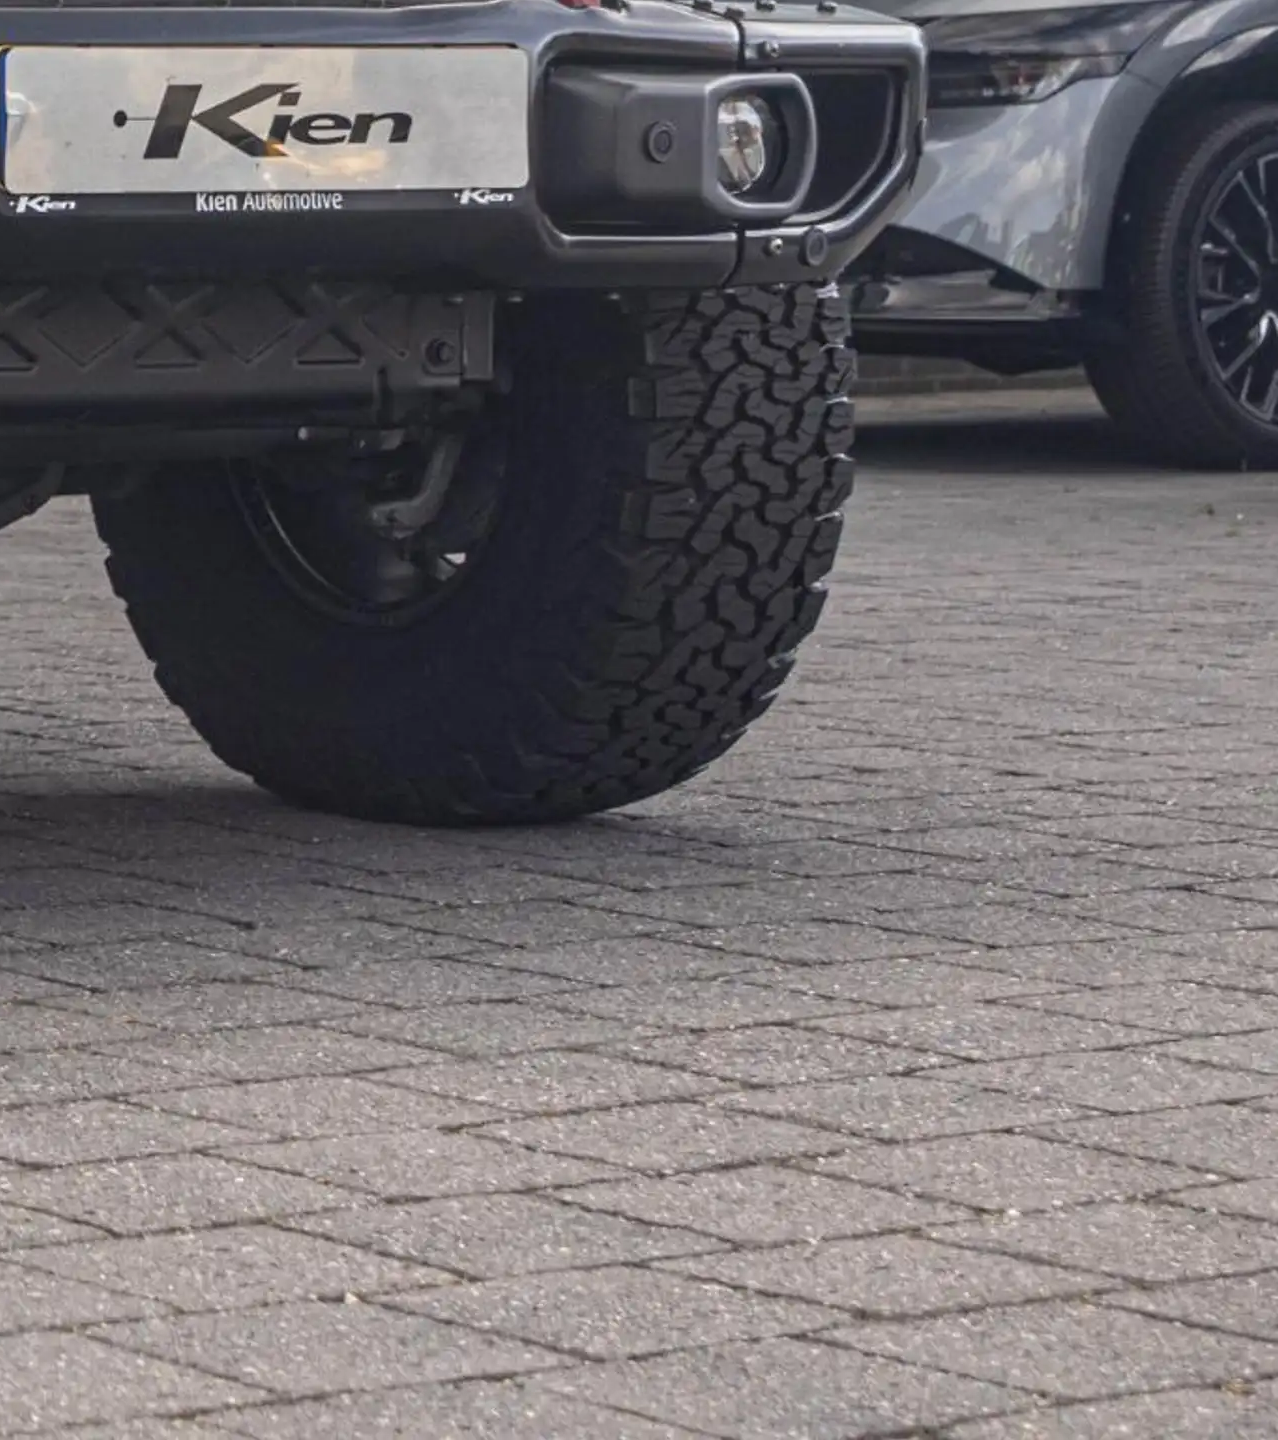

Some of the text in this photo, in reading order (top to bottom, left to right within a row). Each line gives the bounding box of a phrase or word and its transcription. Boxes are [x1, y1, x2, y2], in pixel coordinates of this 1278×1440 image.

[143, 82, 414, 160] Kien
[16, 195, 77, 213] Kien
[195, 191, 343, 212] Kien Automotive
[459, 188, 515, 205] Kien
